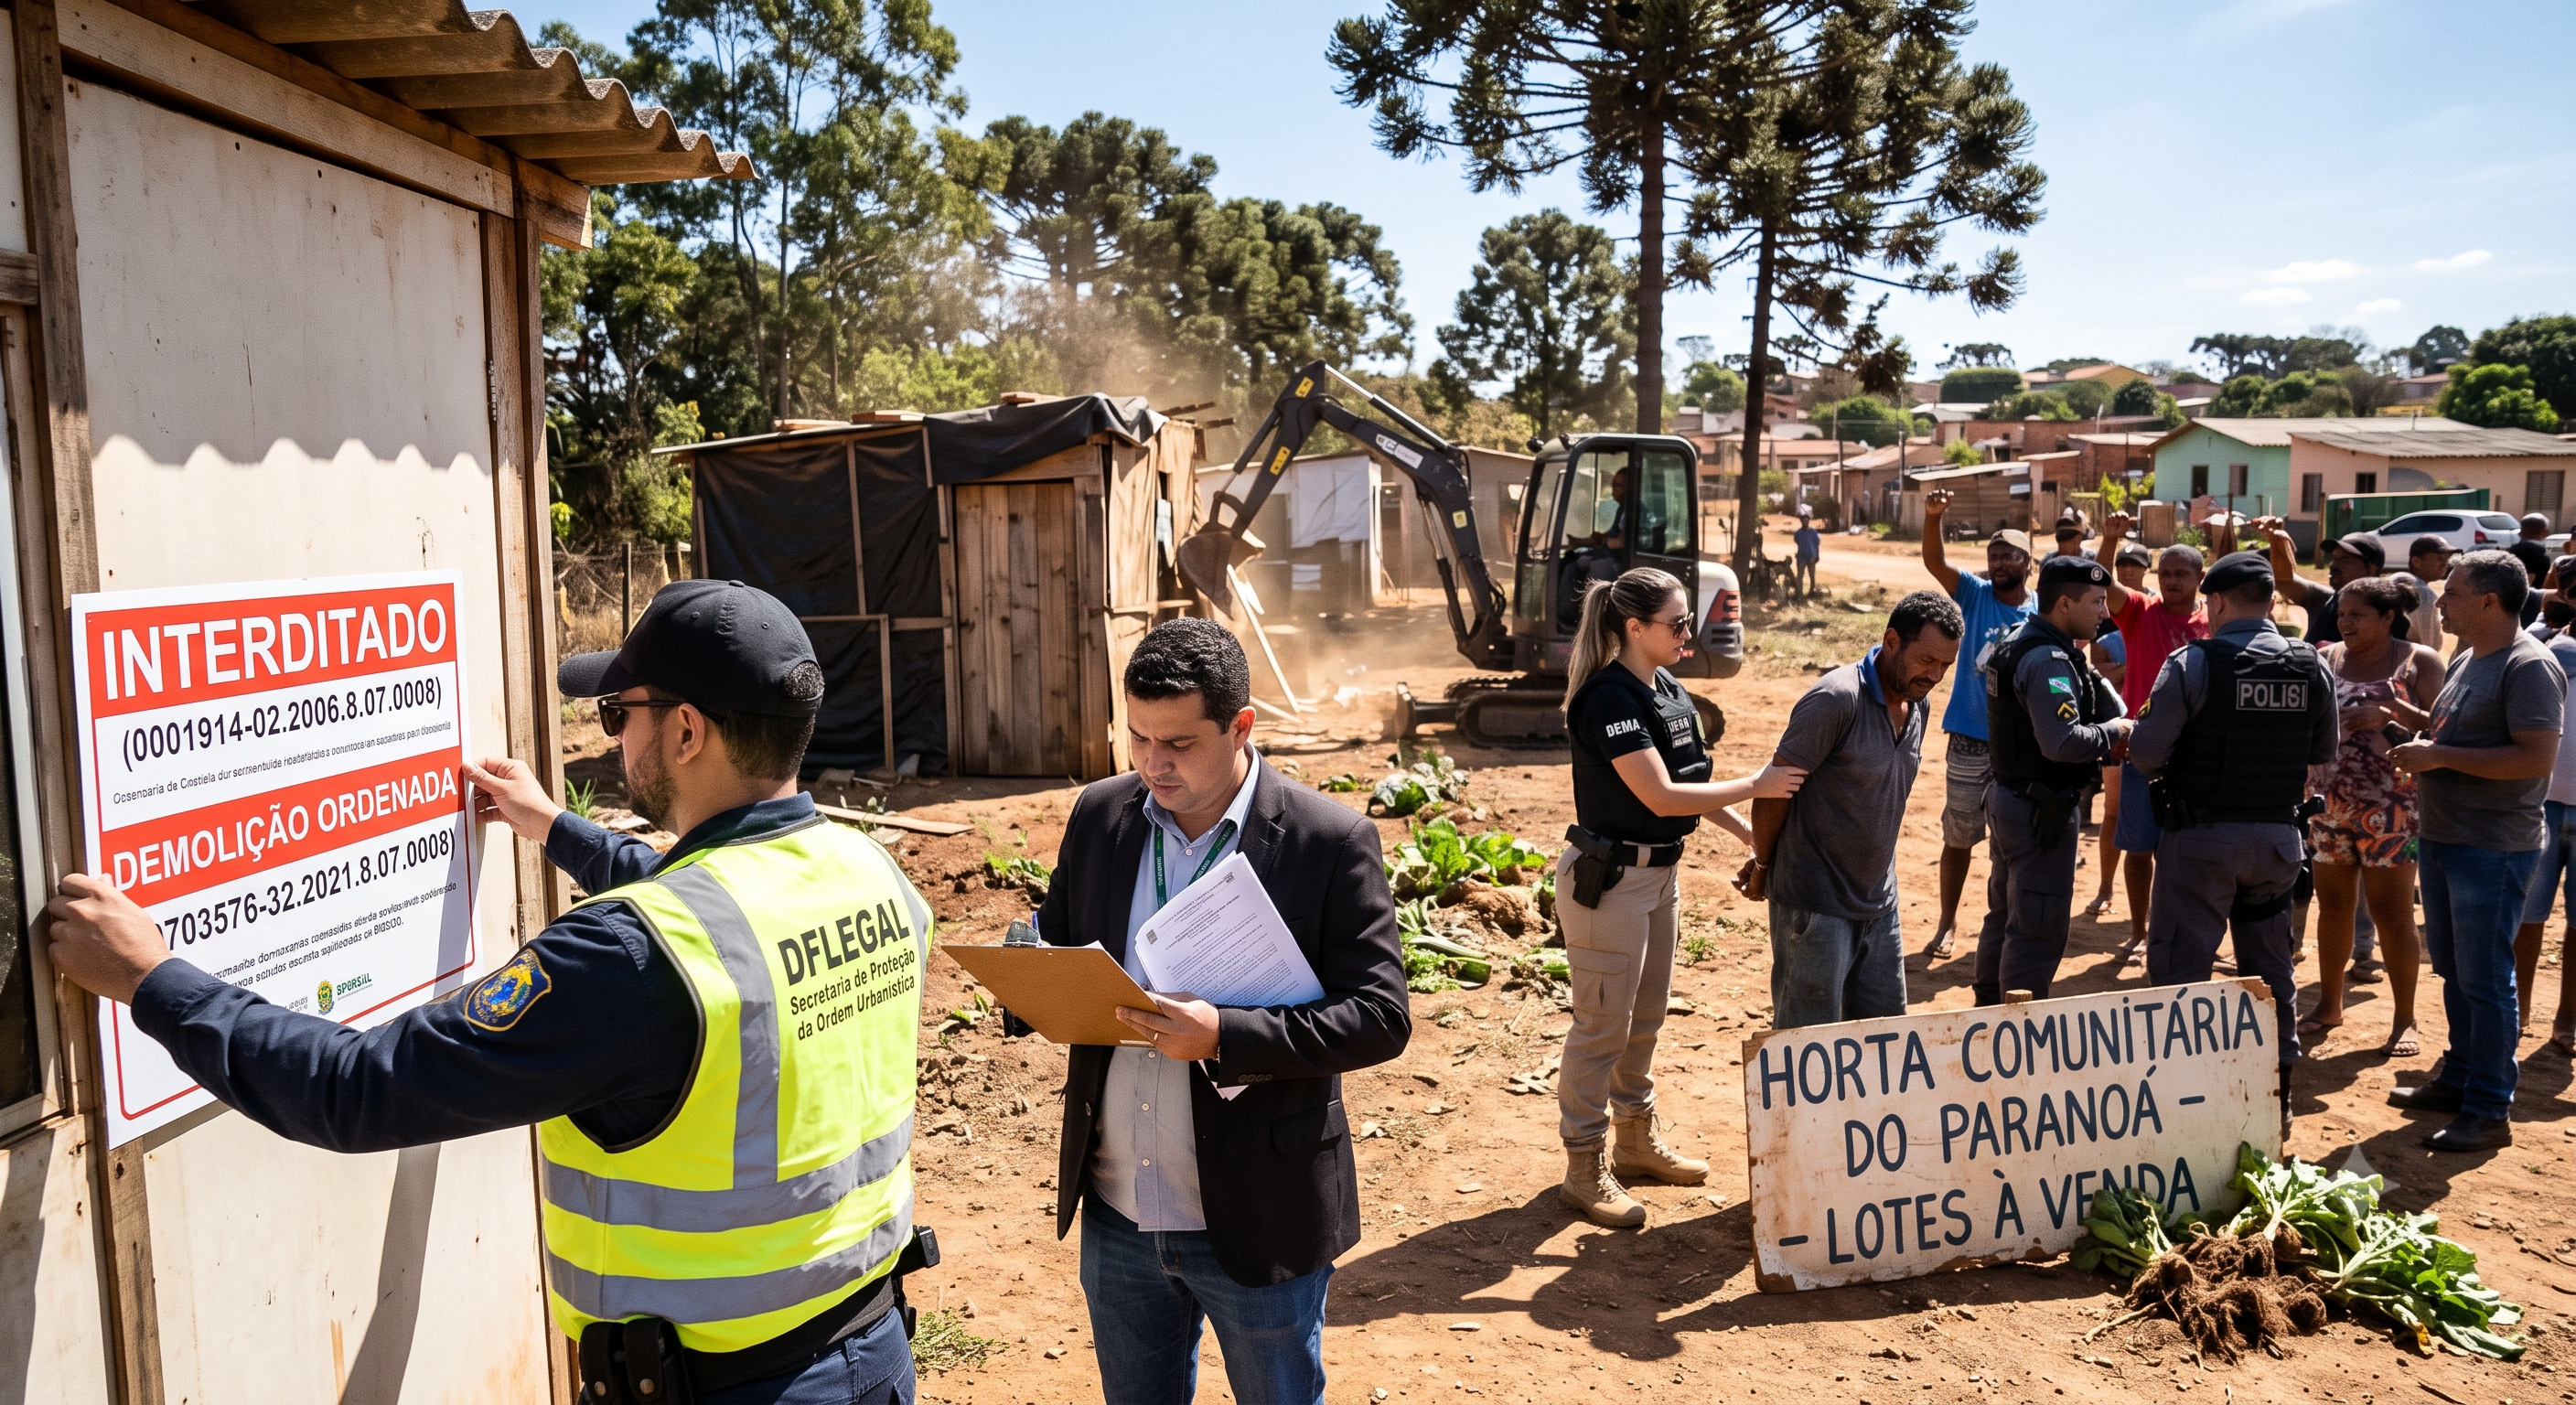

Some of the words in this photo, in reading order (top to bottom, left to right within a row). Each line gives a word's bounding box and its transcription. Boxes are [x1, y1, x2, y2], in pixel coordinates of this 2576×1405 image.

[102, 598, 447, 701] INTERDITADO
[123, 676, 442, 772] (0001914-02.2006.8.07.0008)
[1605, 718, 1641, 738] DEMA
[113, 803, 310, 891] DEMOLIÇÃO
[317, 767, 458, 830] ORDENADA
[155, 828, 456, 951] 703576-32.2021.8.07.0008)
[778, 898, 910, 987] DFLEGAL
[789, 976, 852, 1015] Secretaria
[854, 969, 867, 988] de
[870, 948, 915, 981] Proteção
[798, 1021, 813, 1041] da
[816, 1003, 853, 1032] Ordem
[1759, 1030, 1936, 1110] HORTA
[1961, 987, 2264, 1082] COMUNITÁRIA
[1843, 1113, 1907, 1177] DO
[1940, 1065, 2163, 1164] PARANOÁ
[1827, 1189, 1972, 1265] LOTES
[1993, 1169, 2024, 1240] À
